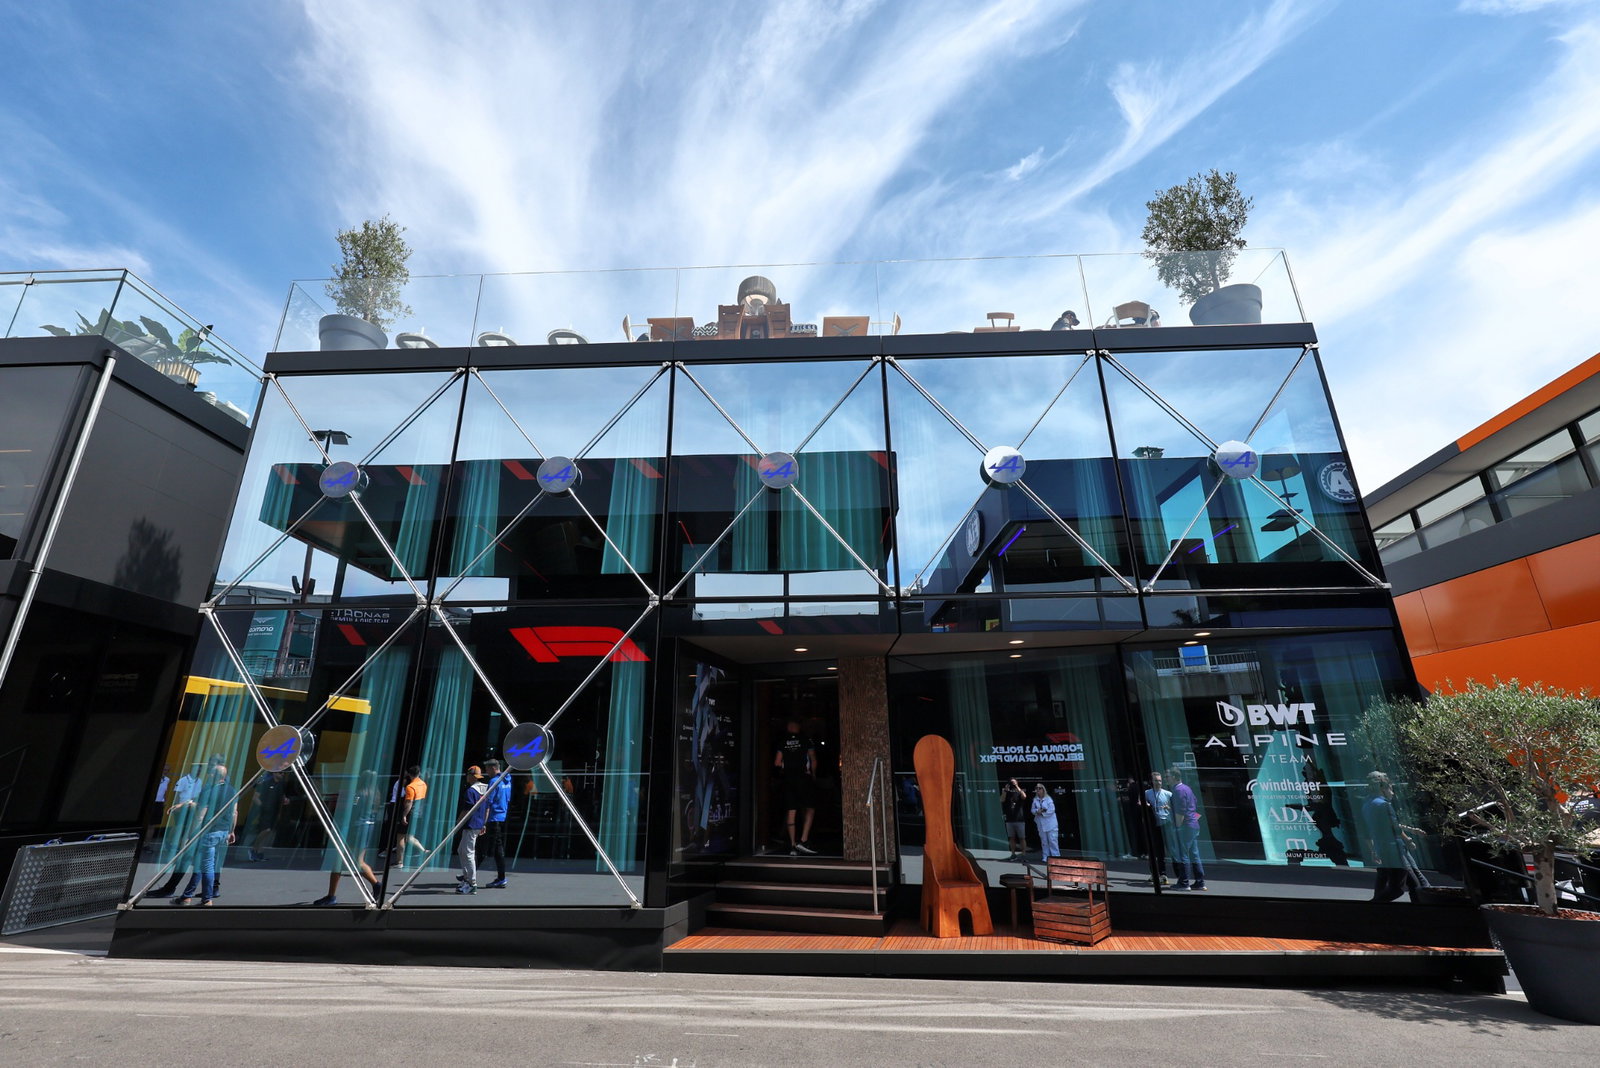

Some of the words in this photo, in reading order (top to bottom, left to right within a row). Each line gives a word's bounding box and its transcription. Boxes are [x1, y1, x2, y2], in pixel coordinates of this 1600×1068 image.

[1246, 702, 1317, 726] BWT
[1205, 733, 1348, 748] ALPINE
[1268, 754, 1313, 764] TEAM
[1259, 778, 1322, 794] windhager
[1268, 805, 1317, 823] ADA
